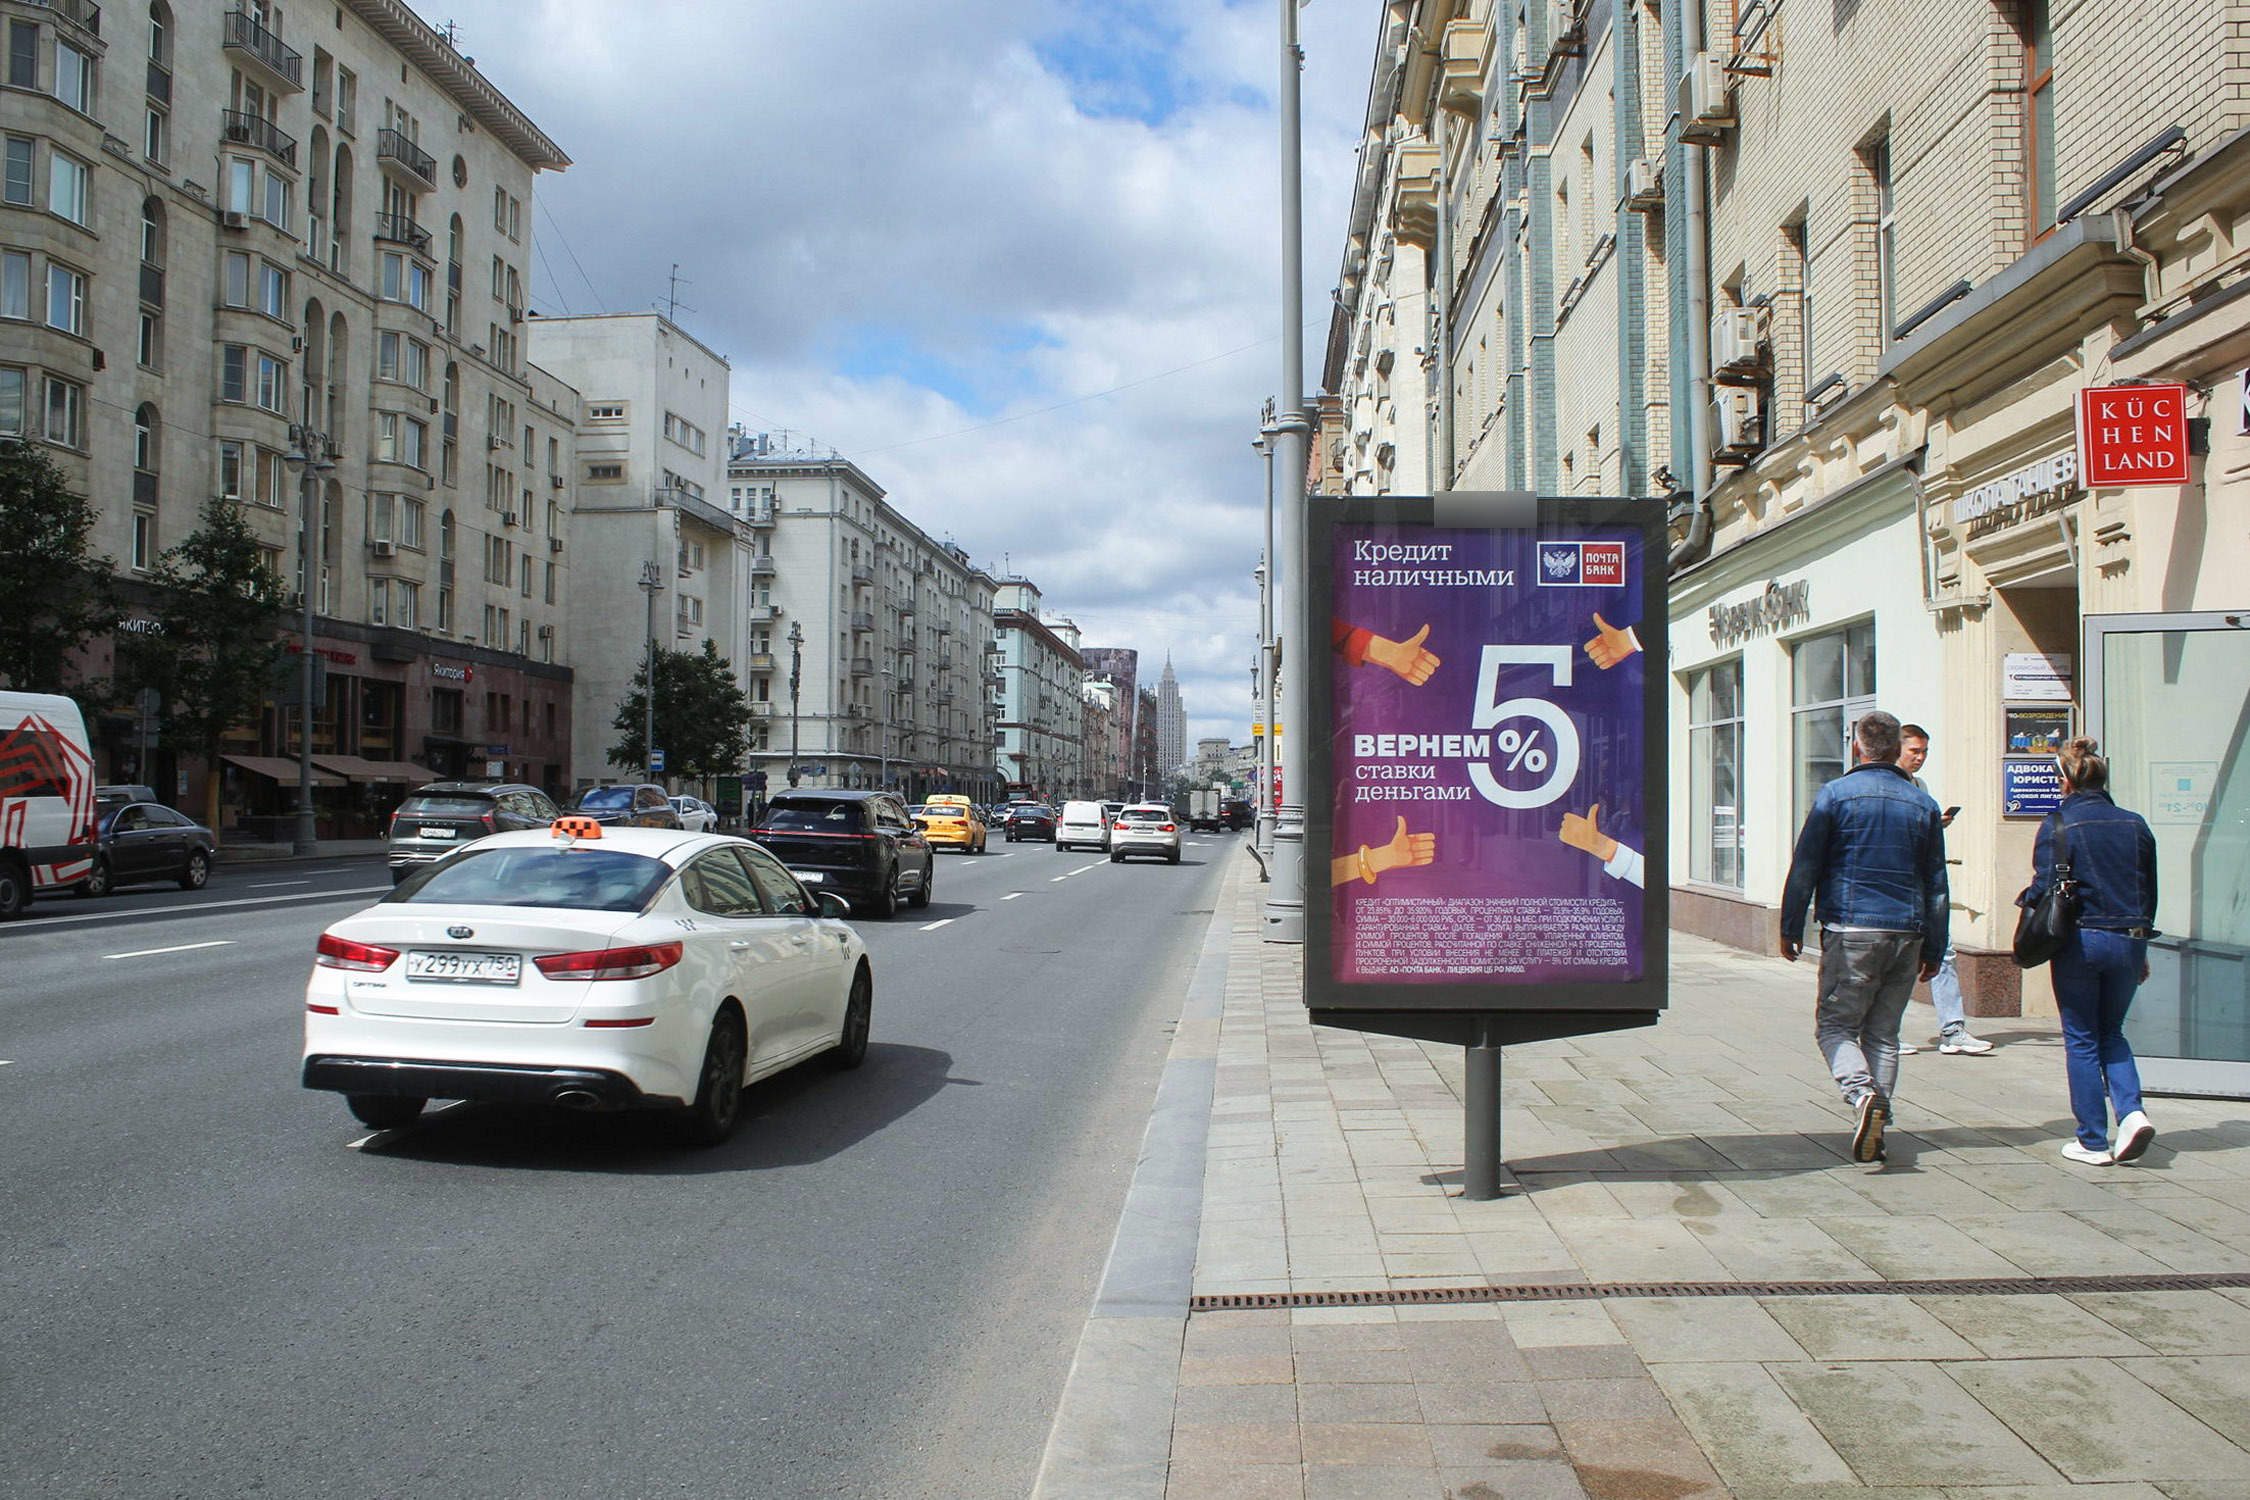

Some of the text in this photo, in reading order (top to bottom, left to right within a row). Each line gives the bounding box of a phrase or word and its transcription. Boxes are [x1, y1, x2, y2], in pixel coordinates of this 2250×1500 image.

[2101, 397, 2170, 419] KÜC
[2103, 424, 2172, 445] HEN
[2104, 450, 2175, 471] LAND
[1953, 451, 2076, 524] ШКОЛА ТАНЦЕВ
[1354, 540, 1452, 565] Кредит
[1585, 552, 1619, 564] ПОЧТА
[1353, 568, 1515, 586] наличными
[1585, 564, 1615, 575] БАНК
[1354, 735, 1490, 757] ВЕРНЕМ
[1355, 763, 1436, 780] ставки
[2007, 764, 2056, 774] АДВОКА
[1355, 786, 1471, 803] деньгами
